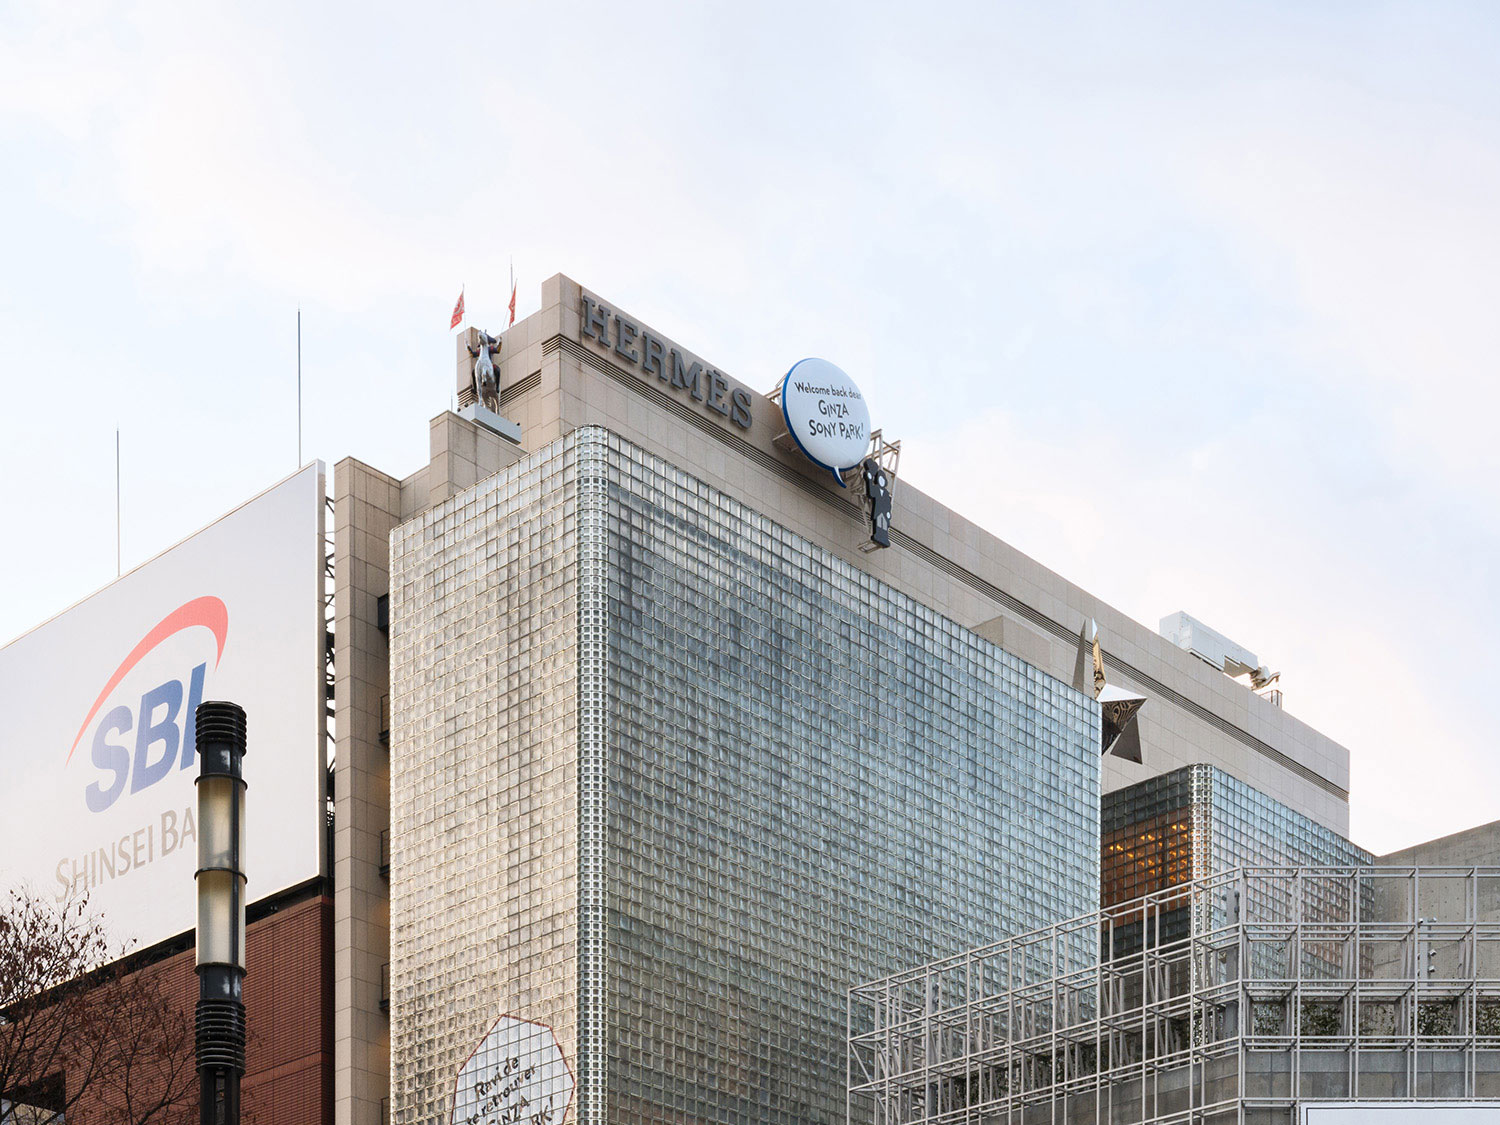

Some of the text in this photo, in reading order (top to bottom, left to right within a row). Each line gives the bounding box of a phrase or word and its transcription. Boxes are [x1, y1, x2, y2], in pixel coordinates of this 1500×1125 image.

[794, 381, 830, 396] Welcome
[831, 384, 848, 397] back
[818, 399, 850, 418] GINZA
[808, 419, 864, 440] SONY PARK!
[85, 661, 206, 813] SBI
[55, 806, 197, 904] SHINSEI BA
[503, 1057, 519, 1076] de
